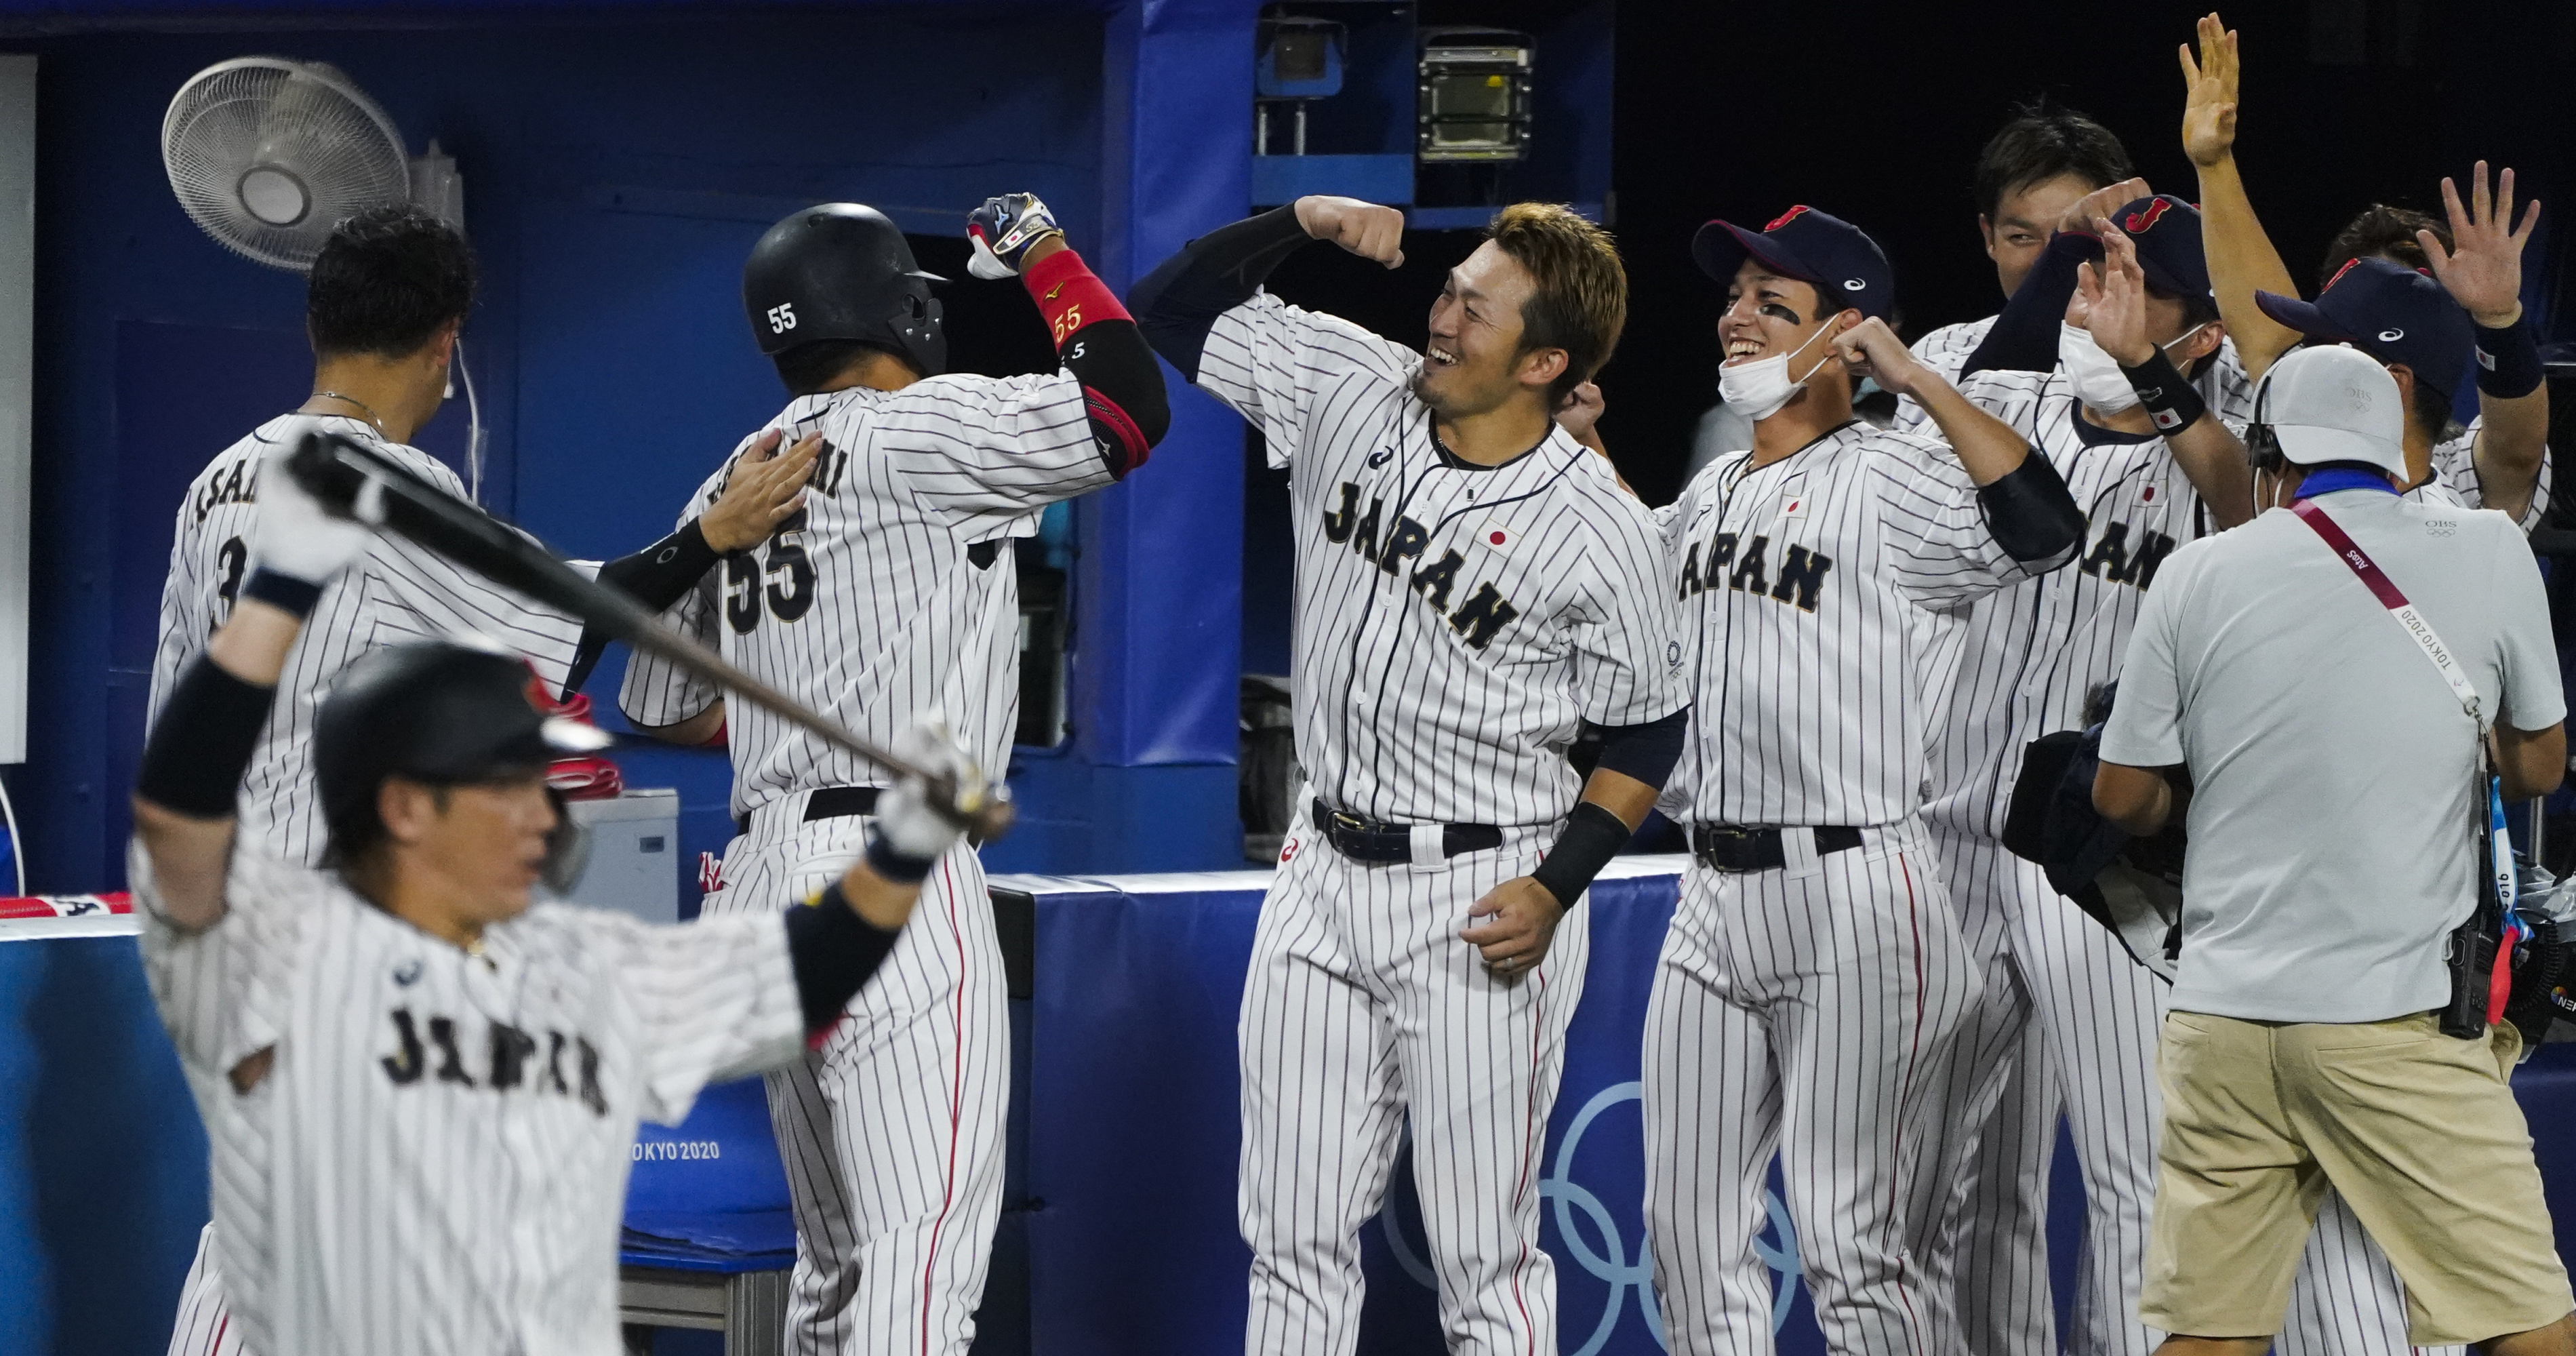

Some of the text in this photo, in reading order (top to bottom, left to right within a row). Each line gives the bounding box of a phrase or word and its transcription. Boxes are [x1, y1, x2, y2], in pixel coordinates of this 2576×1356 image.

[2125, 197, 2172, 234] J
[767, 302, 797, 334] 55
[1055, 304, 1082, 343] 55
[2425, 520, 2457, 528] OBS
[727, 506, 816, 636] 55
[1324, 481, 1520, 650] JAPAN
[1678, 532, 1833, 614] APAN
[2346, 550, 2369, 570] Atos
[2401, 610, 2451, 671] TOKYO 2020
[632, 1141, 720, 1161] OKYO 2020
